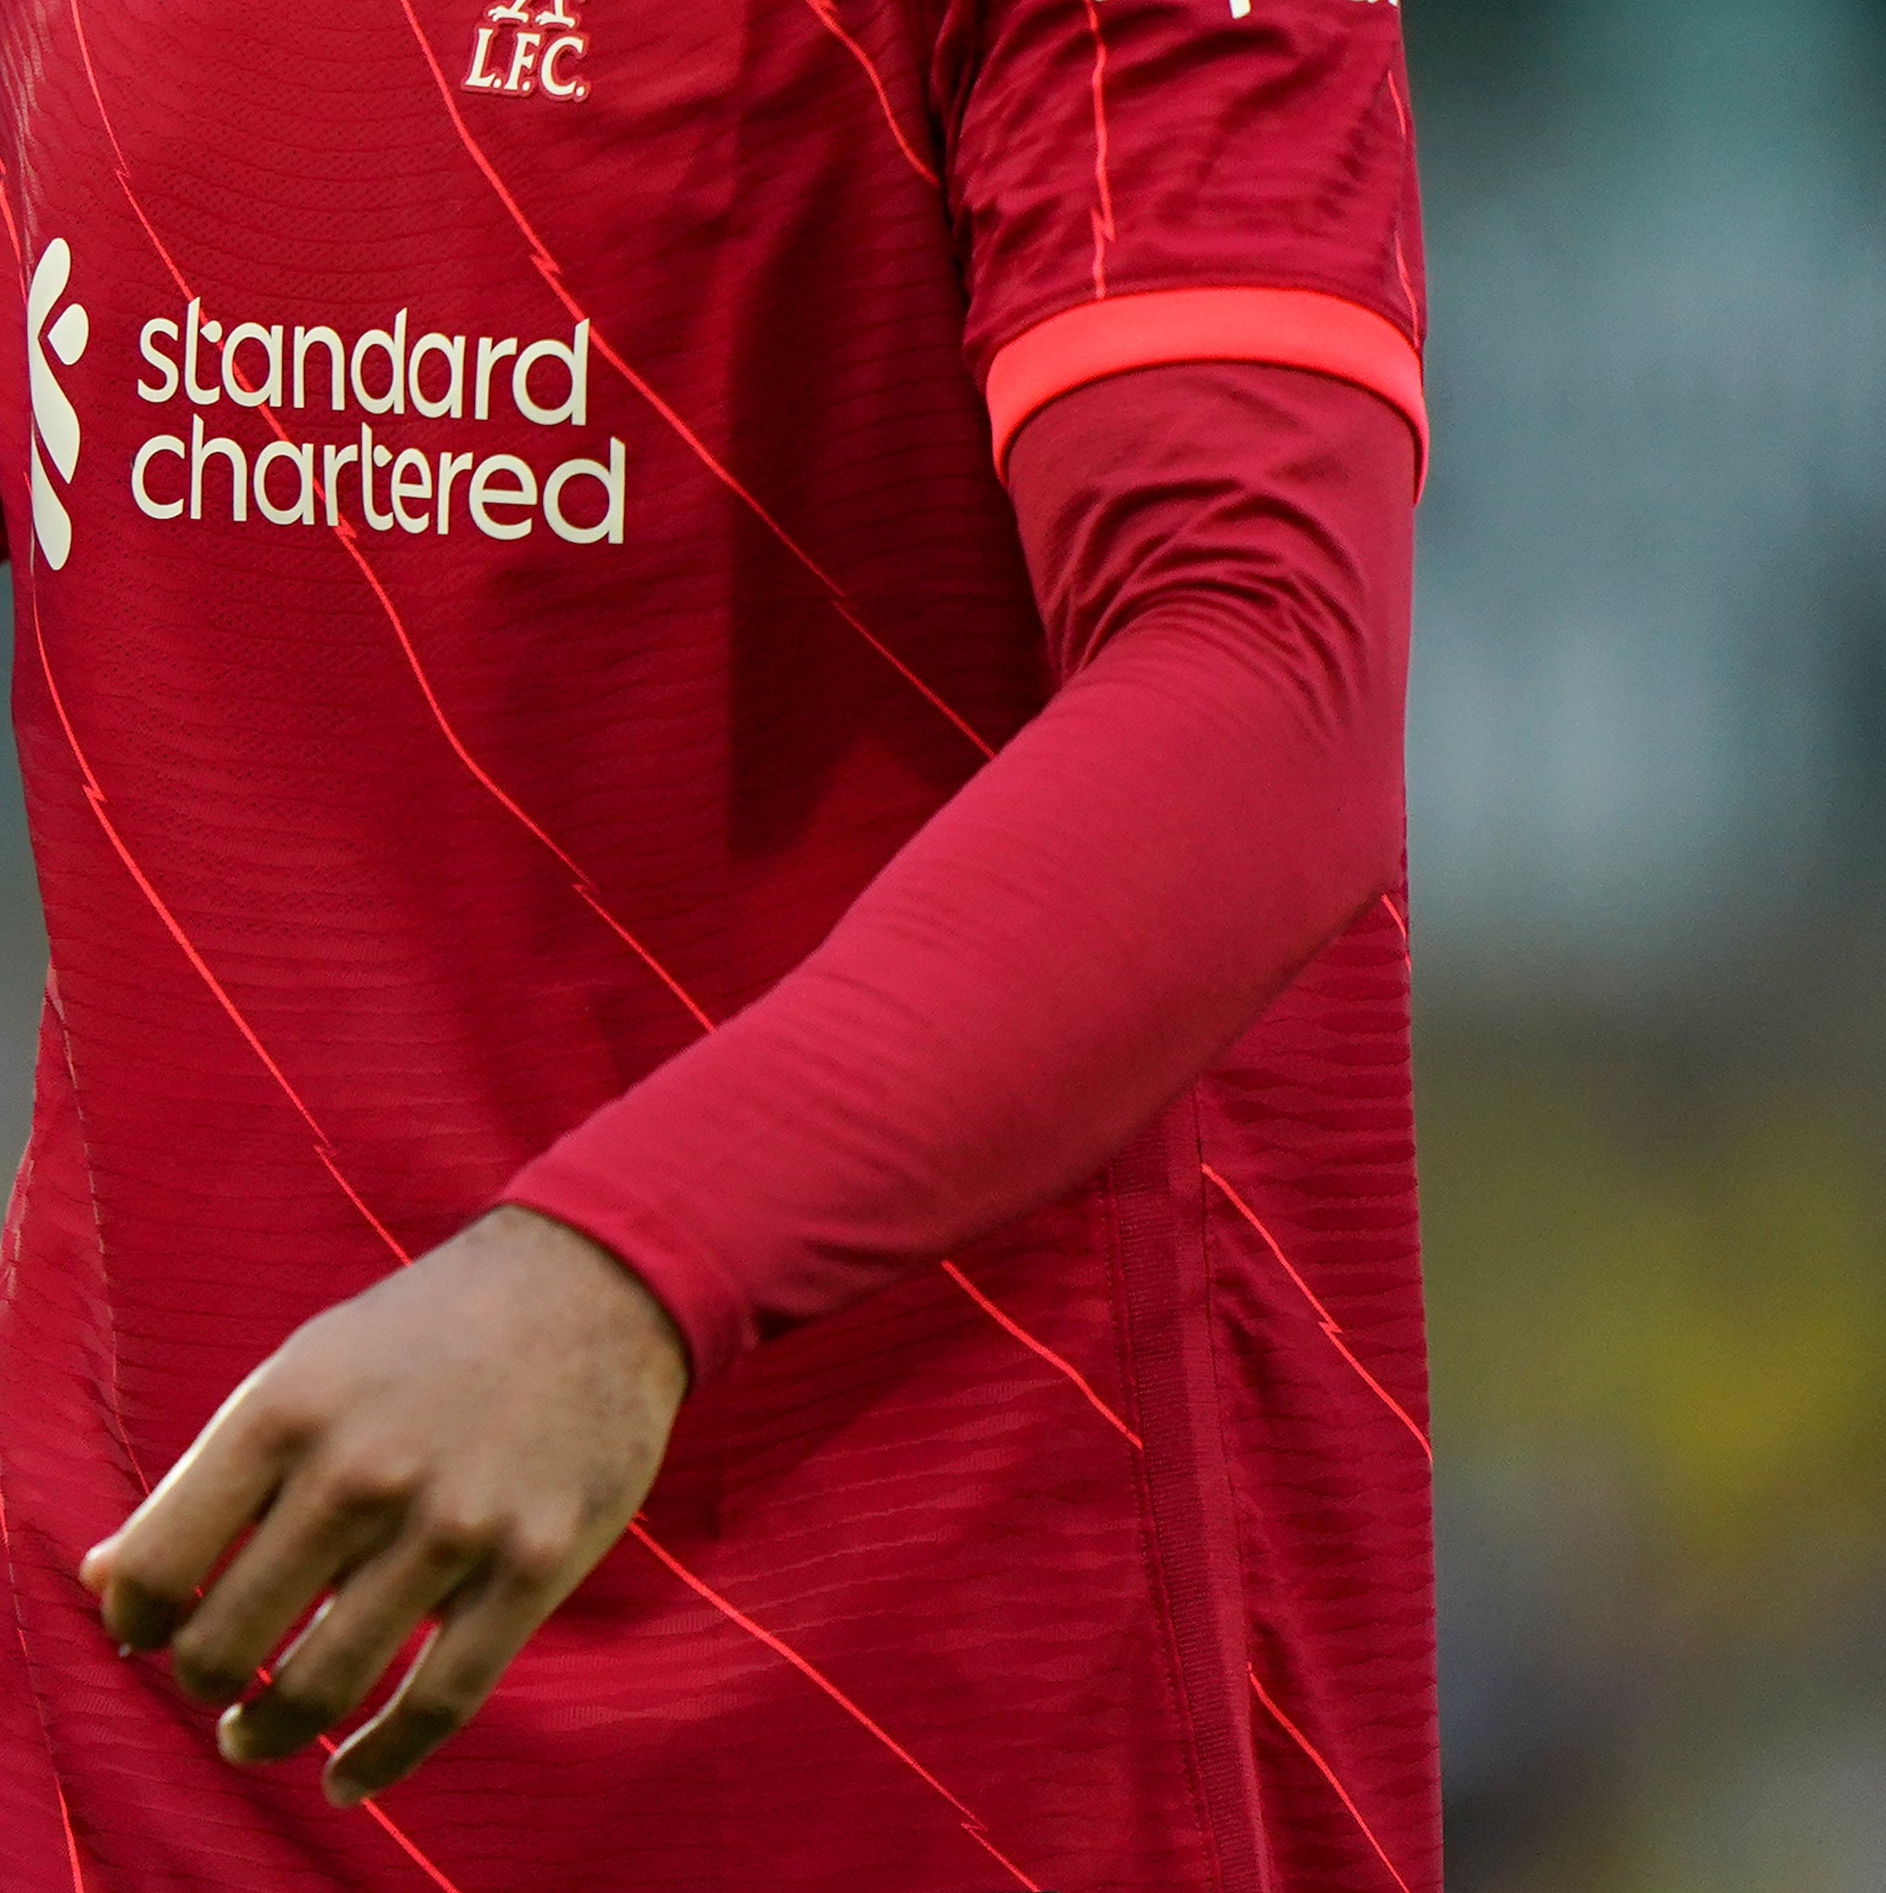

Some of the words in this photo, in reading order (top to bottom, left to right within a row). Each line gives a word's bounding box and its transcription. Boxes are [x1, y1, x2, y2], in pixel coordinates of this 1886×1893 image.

[465, 27, 585, 96] L.F.C.
[137, 296, 590, 426] standard
[131, 413, 626, 544] chartered
